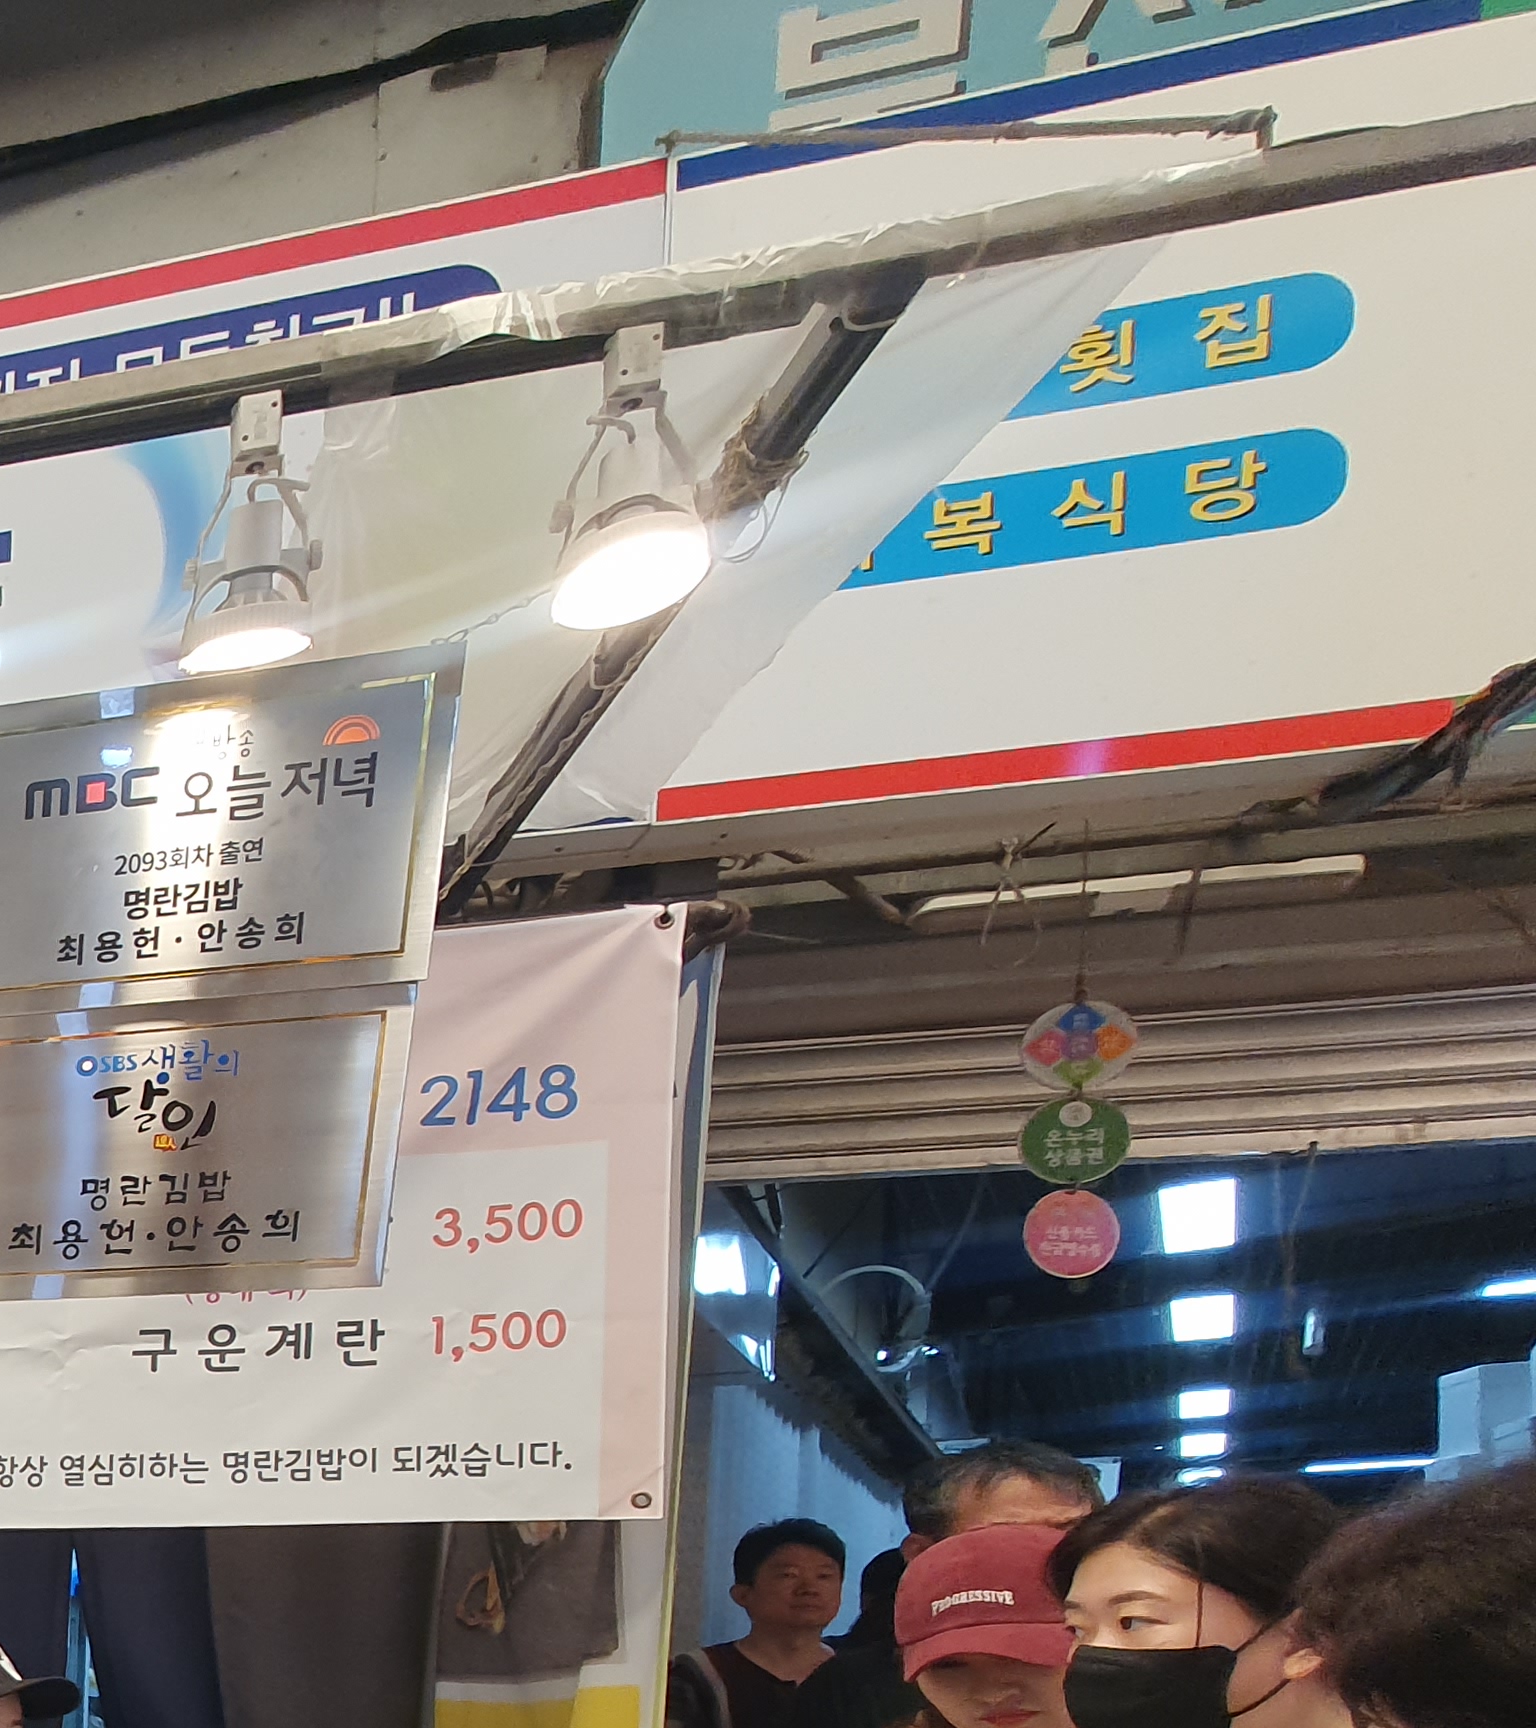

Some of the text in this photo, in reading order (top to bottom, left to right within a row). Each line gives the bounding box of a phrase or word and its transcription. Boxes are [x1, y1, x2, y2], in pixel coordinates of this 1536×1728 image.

[854, 450, 1268, 576] 복식당
[115, 836, 265, 877] 2093회차 출연
[123, 877, 244, 921] 명란김밥
[92, 1078, 218, 1151] 달인
[80, 1168, 233, 1212] 명란김밥
[432, 1198, 584, 1254] 3,500
[431, 1308, 568, 1364] 1,500
[59, 1452, 209, 1488] 열심히하는
[222, 1446, 378, 1484] 명란김밥이
[391, 1440, 573, 1480] 되겠습니다.
